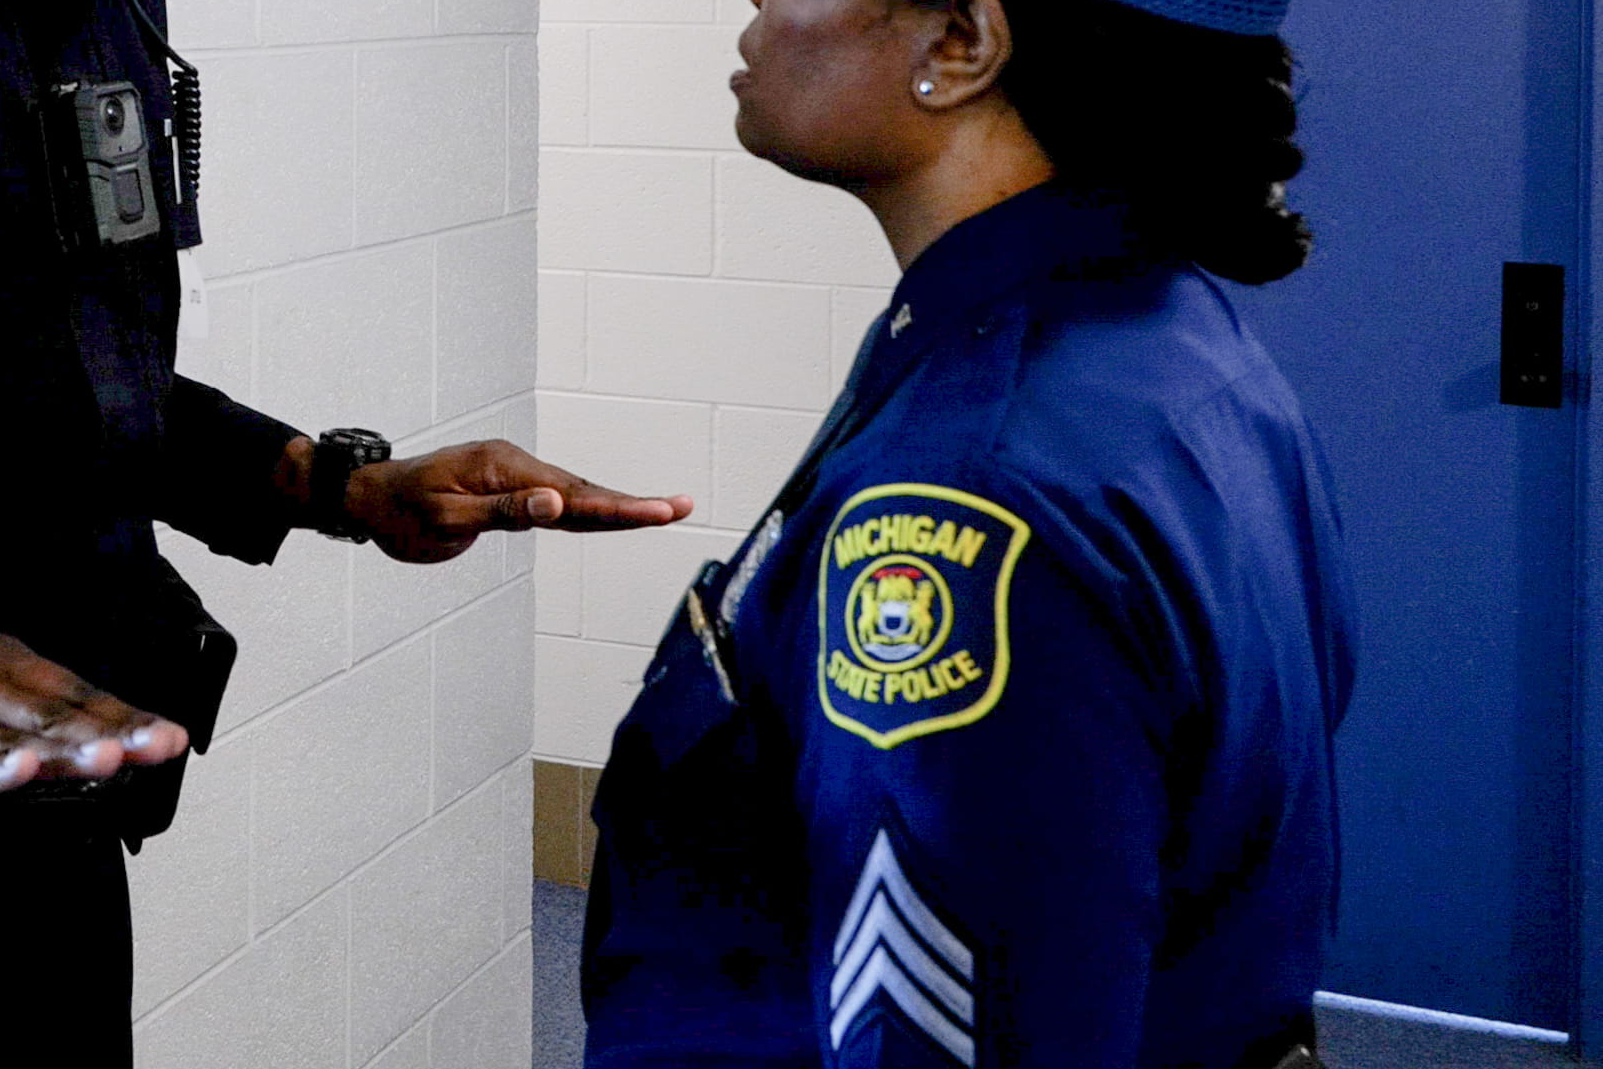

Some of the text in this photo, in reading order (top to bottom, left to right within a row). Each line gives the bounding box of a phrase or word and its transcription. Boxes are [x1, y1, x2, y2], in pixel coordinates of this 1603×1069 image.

[834, 514, 987, 570] MICHIGAN
[827, 649, 983, 705] STATE POLICE
